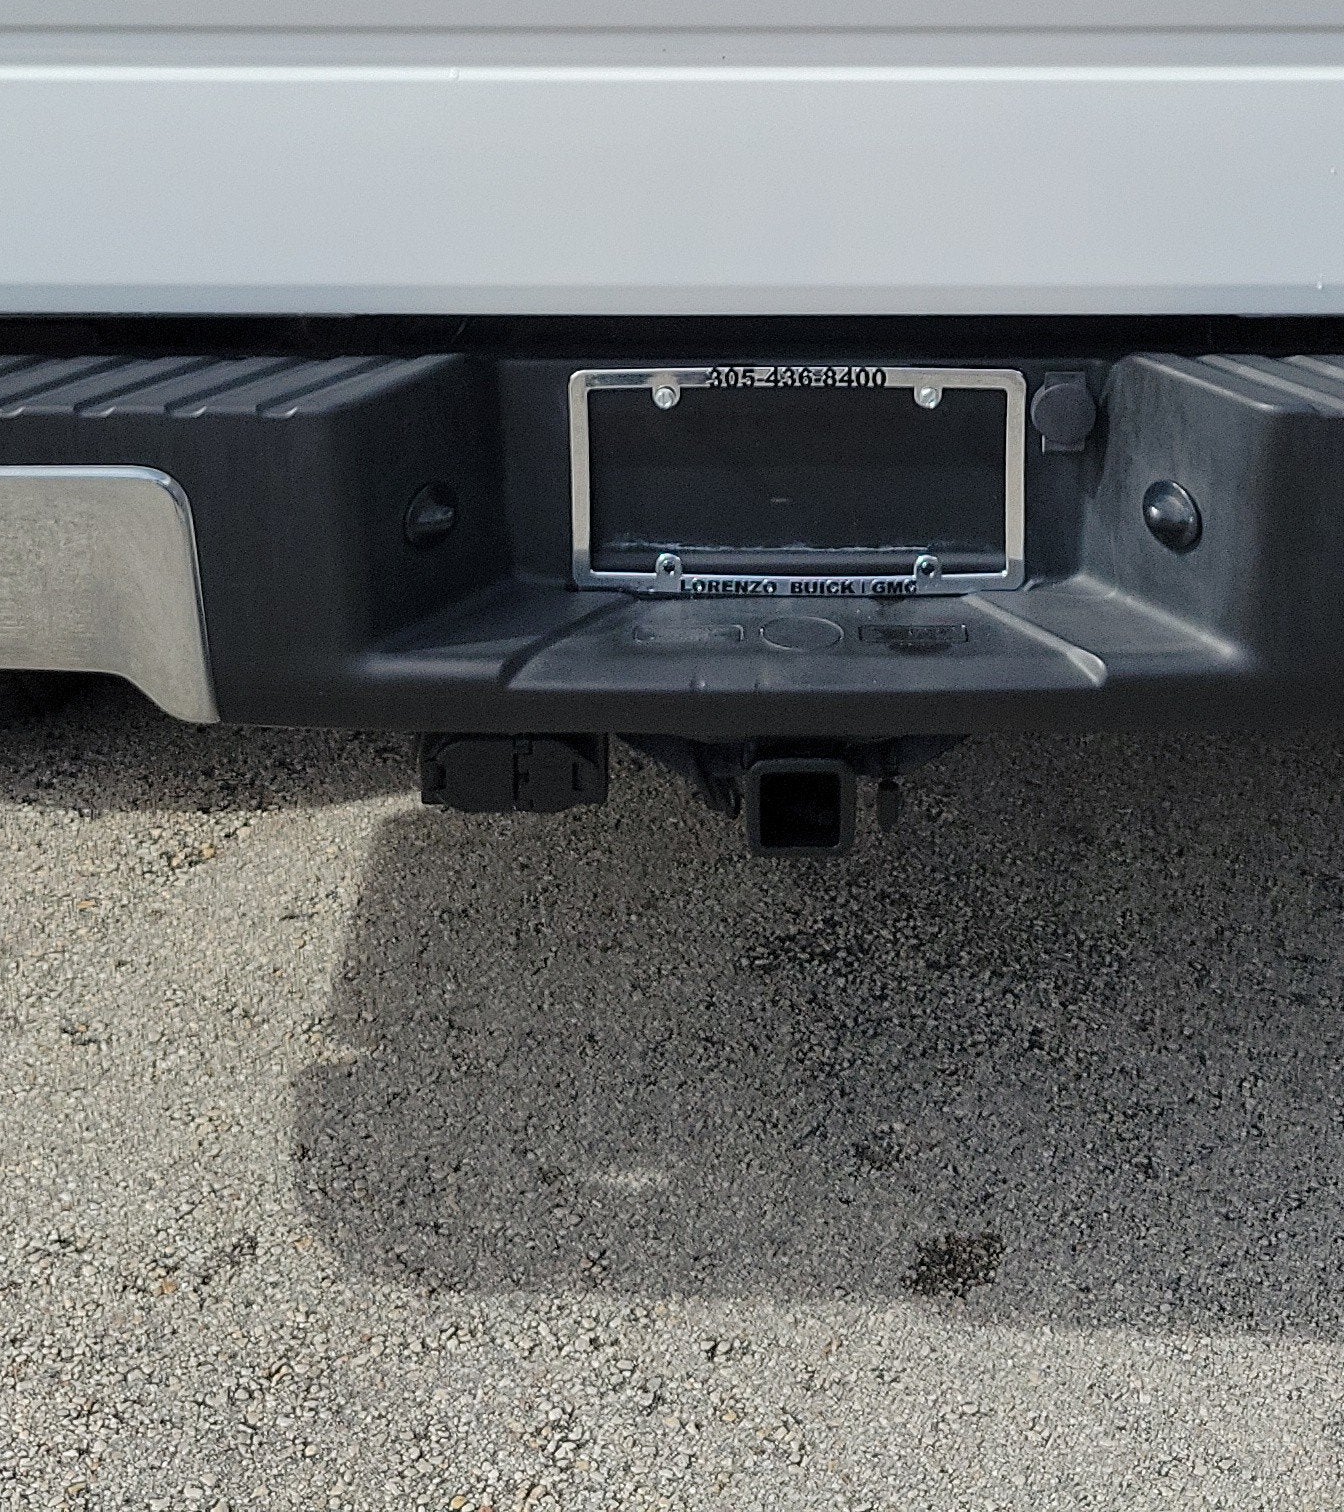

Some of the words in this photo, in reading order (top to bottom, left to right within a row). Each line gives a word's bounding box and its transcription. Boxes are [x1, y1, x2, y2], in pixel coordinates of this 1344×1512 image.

[708, 366, 888, 388] 305-436-8400
[680, 578, 778, 594] LORENZO
[790, 578, 857, 594] BUICK
[871, 578, 918, 594] GMC
